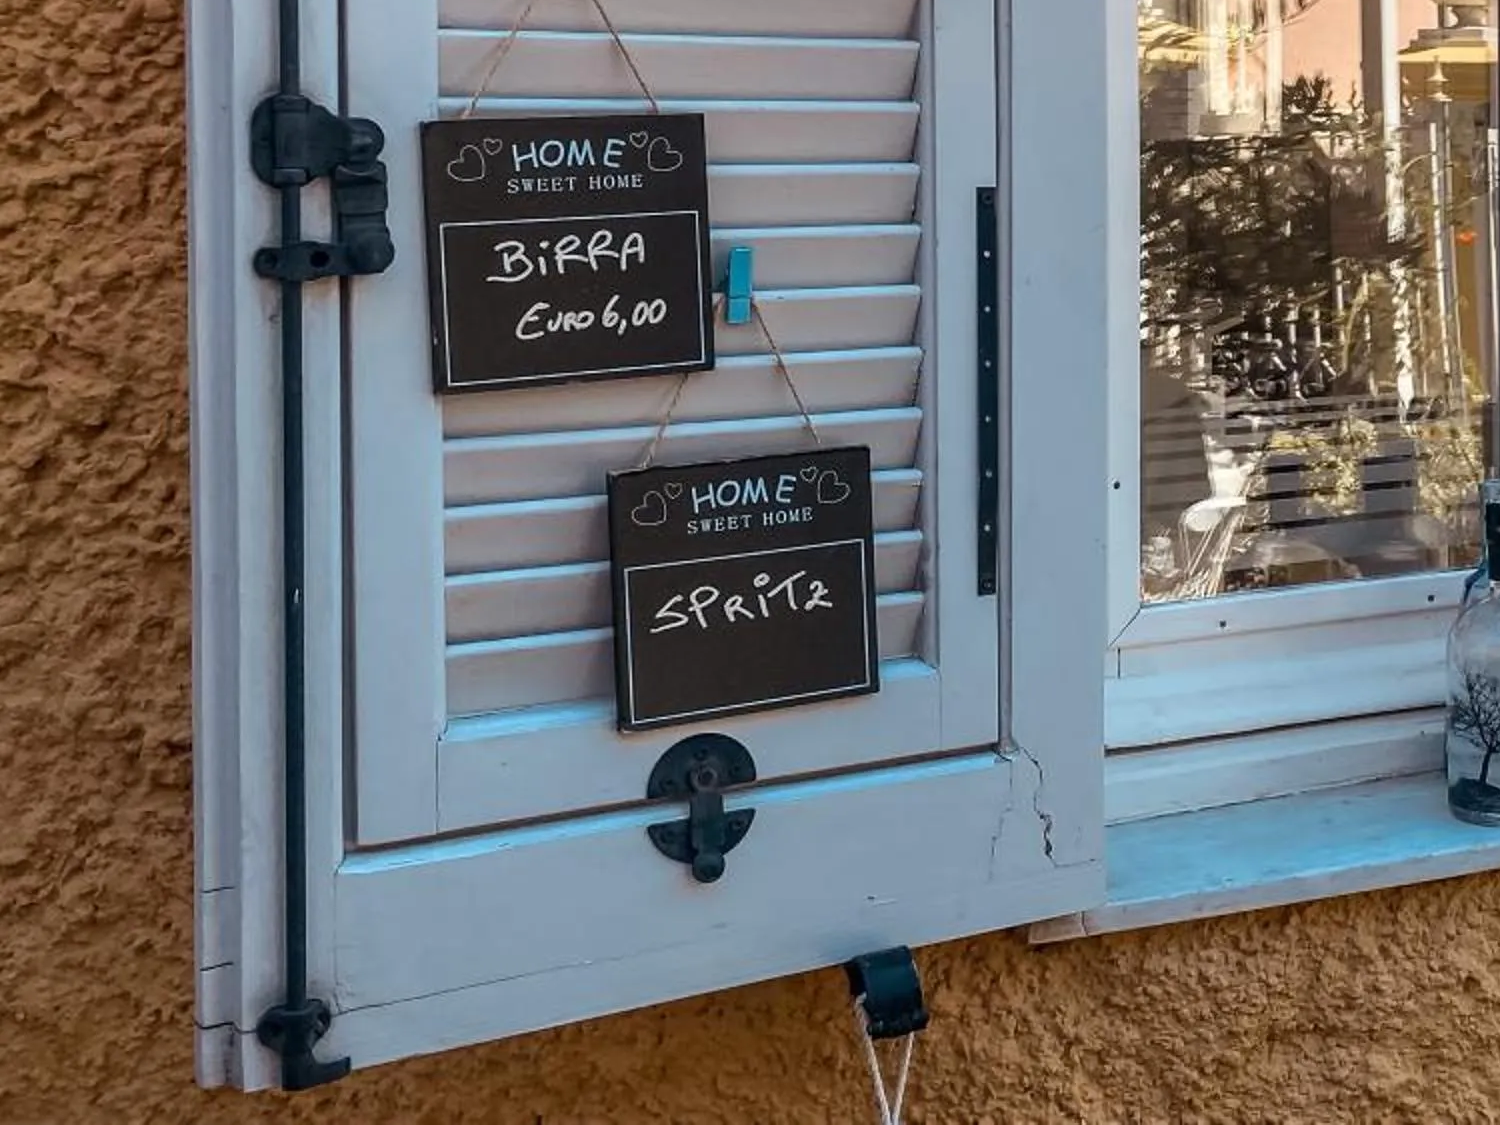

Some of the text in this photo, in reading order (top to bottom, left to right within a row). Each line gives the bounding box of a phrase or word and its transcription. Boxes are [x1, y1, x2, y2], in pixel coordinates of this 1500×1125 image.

[511, 138, 628, 172] HOME
[506, 173, 644, 194] SWEET HOME
[601, 294, 667, 335] 6,00
[691, 474, 797, 514] HOME
[687, 506, 813, 535] SWEET HOME
